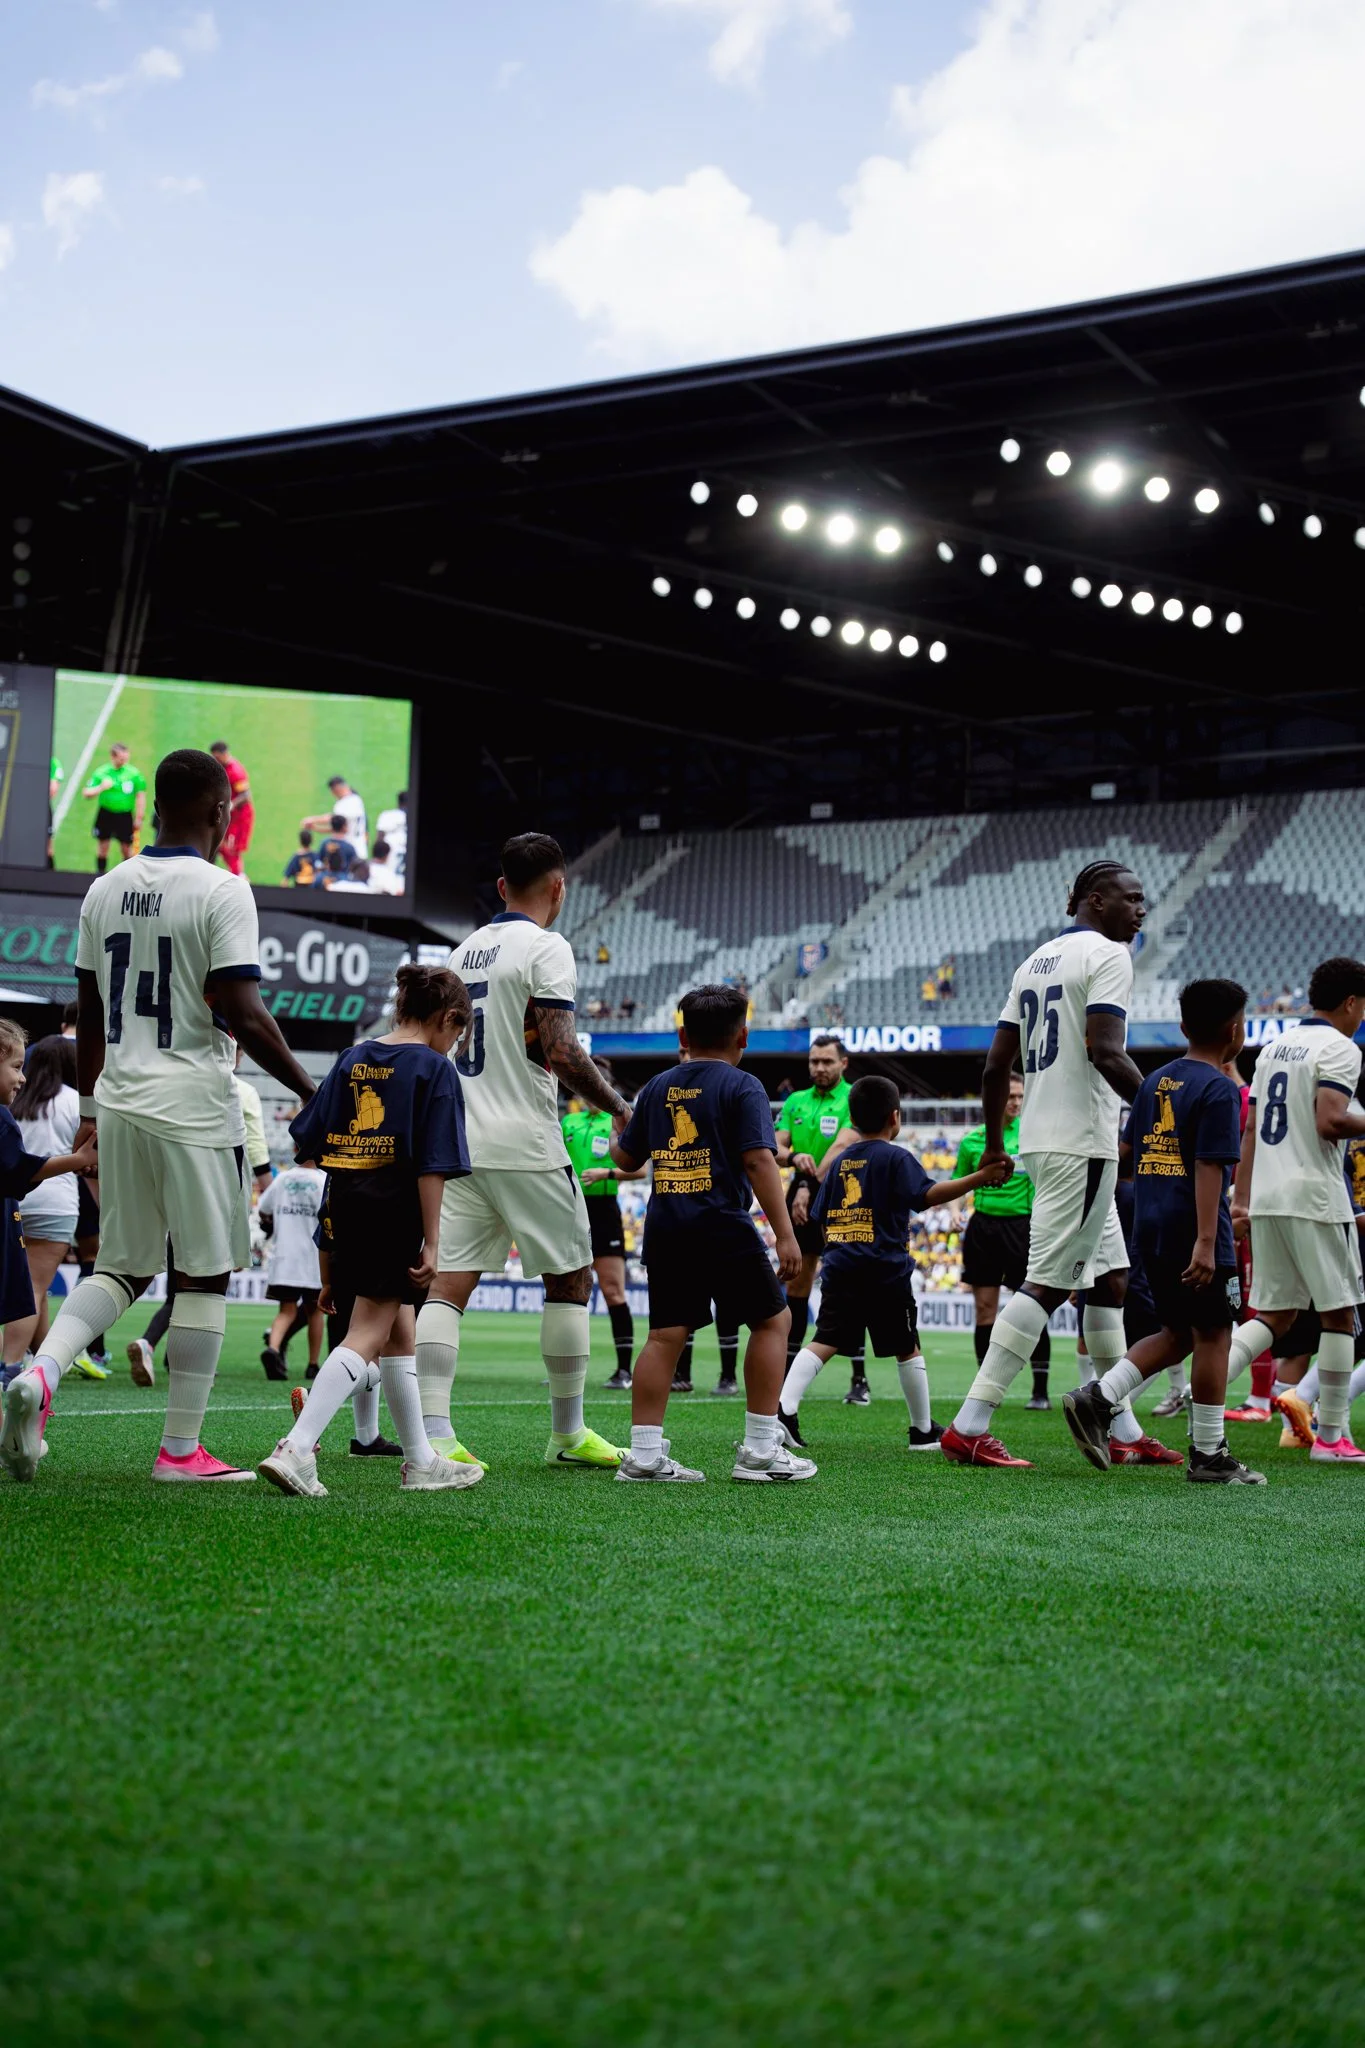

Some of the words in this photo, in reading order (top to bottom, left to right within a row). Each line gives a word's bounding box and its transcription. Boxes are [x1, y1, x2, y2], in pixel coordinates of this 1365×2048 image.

[104, 932, 173, 1049] 14
[270, 989, 367, 1022] FIELD
[1020, 984, 1063, 1074] 25
[1260, 1071, 1288, 1146] 8
[326, 1132, 395, 1147] SERVIEXPRESS
[650, 1148, 711, 1161] SERVIEXPRESS
